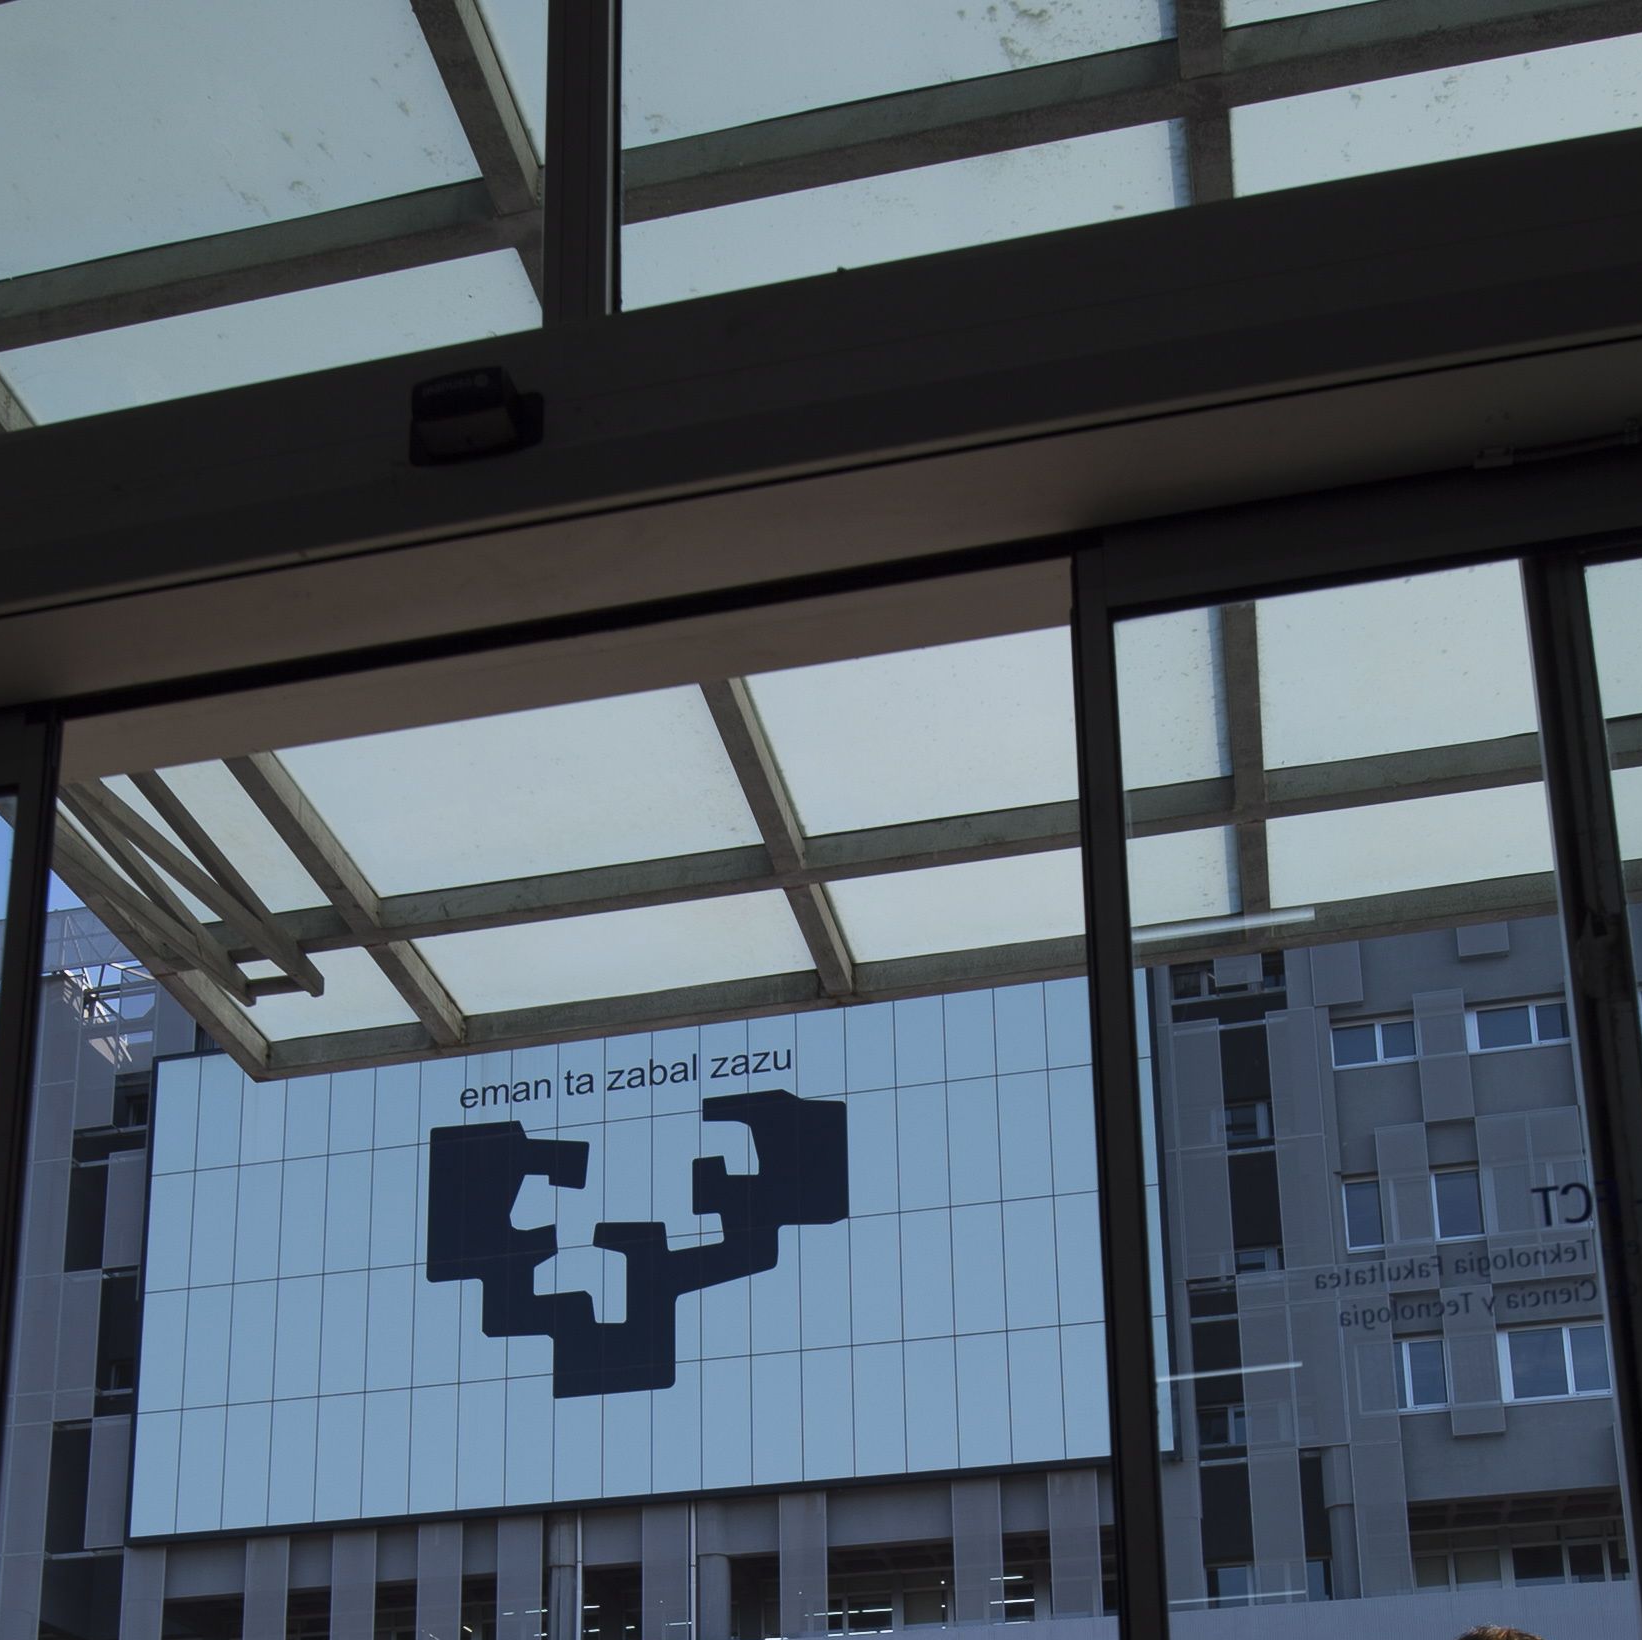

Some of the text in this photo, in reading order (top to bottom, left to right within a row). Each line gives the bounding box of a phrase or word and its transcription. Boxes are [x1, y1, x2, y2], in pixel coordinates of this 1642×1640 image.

[459, 1047, 793, 1109] eman ta zabal zazu
